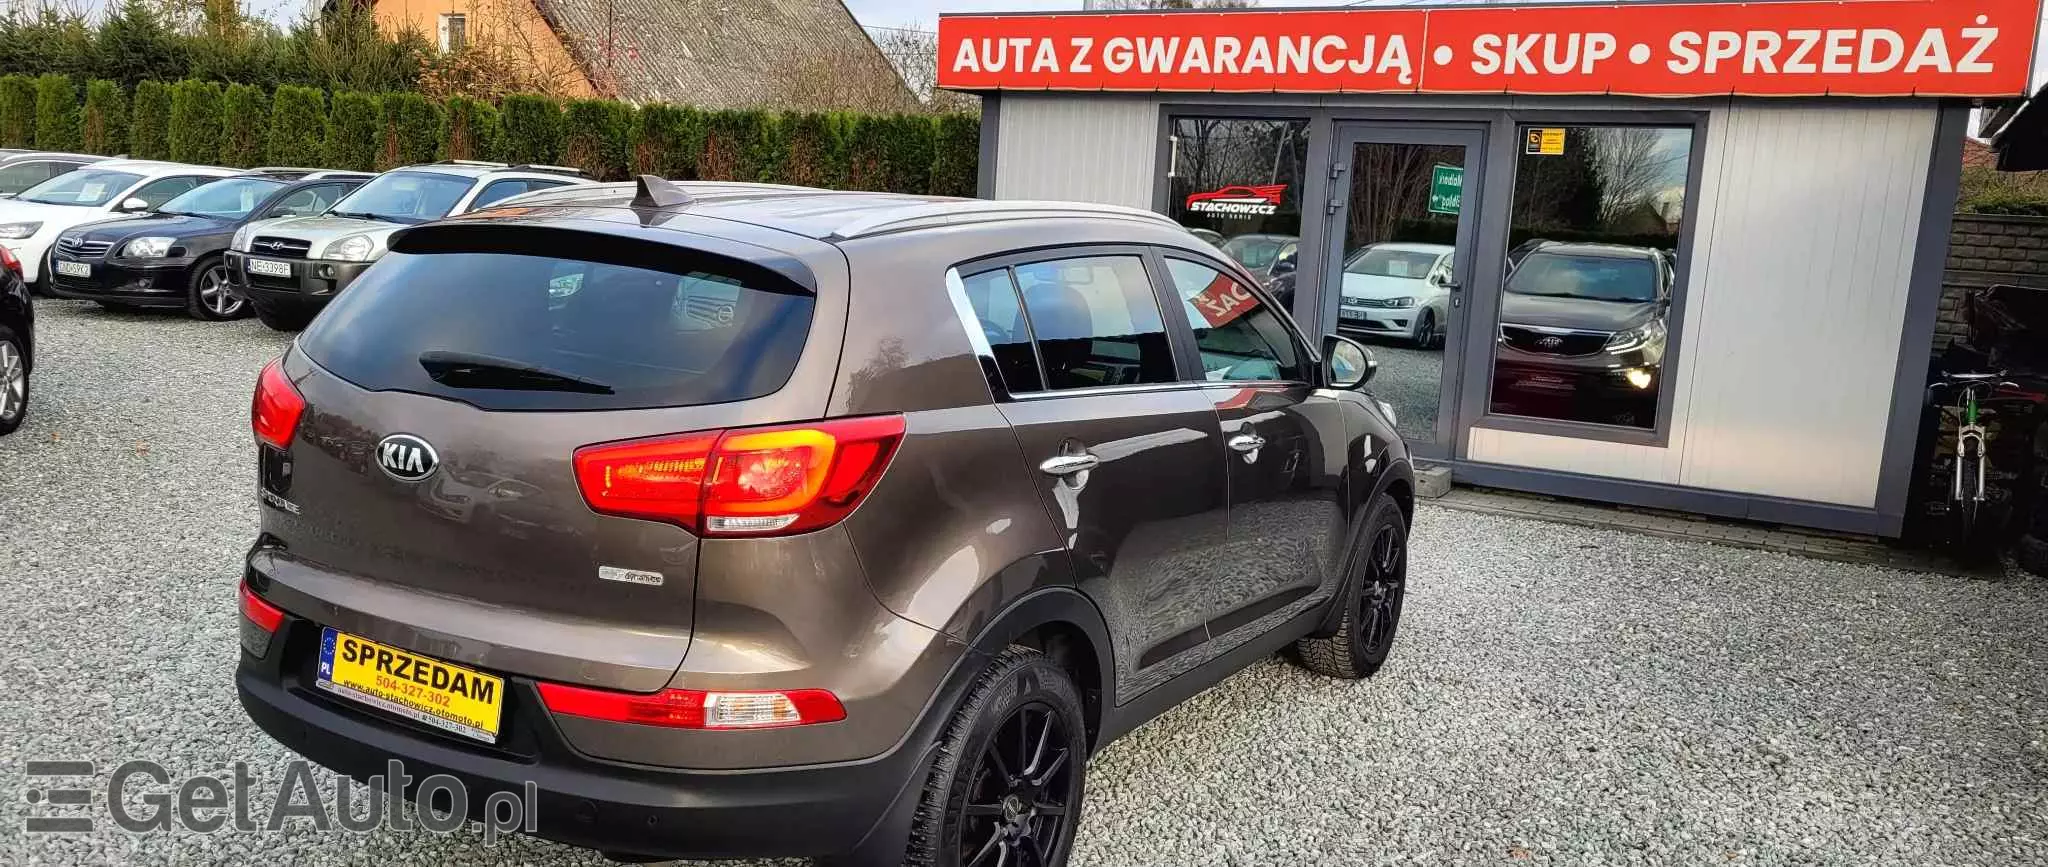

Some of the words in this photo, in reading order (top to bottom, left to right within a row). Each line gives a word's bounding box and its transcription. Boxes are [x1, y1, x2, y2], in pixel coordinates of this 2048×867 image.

[952, 37, 1060, 73] AUTA
[1070, 37, 1094, 73] Z
[1103, 34, 1413, 85] GWARANCJĄ
[1471, 32, 1617, 75] SKUP
[1667, 14, 1998, 75] SPRZEDAŻ
[1190, 201, 1277, 215] STACHOWICZ
[383, 442, 424, 473] KIA
[320, 661, 331, 675] PL
[342, 639, 495, 705] SPRZEDAM
[375, 674, 451, 709] 504-327-302
